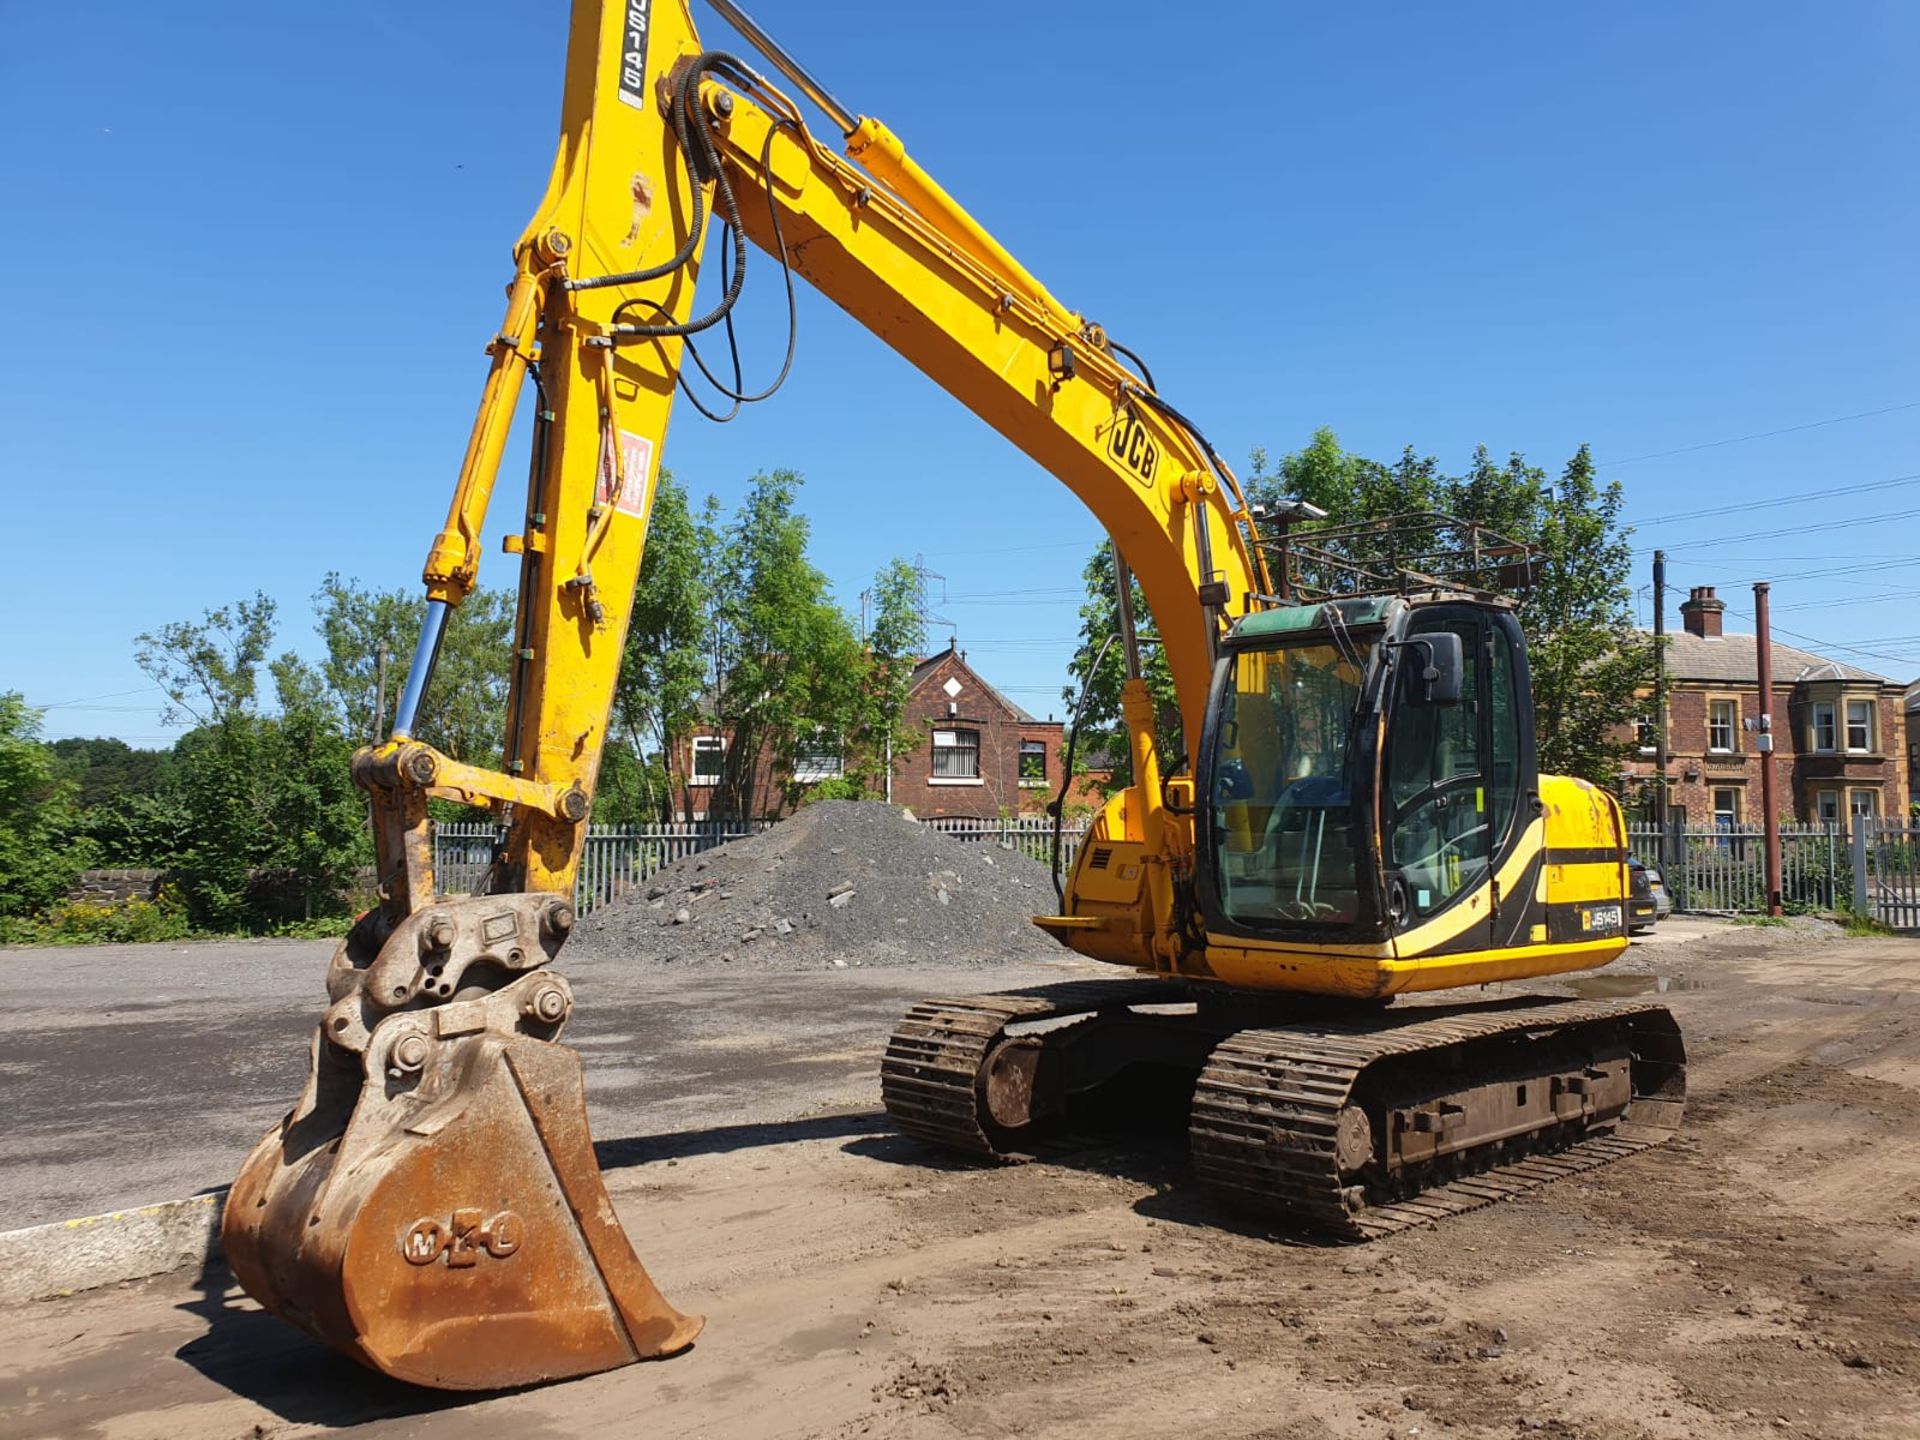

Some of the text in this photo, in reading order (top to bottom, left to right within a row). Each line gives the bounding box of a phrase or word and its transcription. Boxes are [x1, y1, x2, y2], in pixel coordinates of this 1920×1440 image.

[624, 0, 647, 89] JS145
[1113, 411, 1155, 479] JCB
[1591, 911, 1618, 926] JS145
